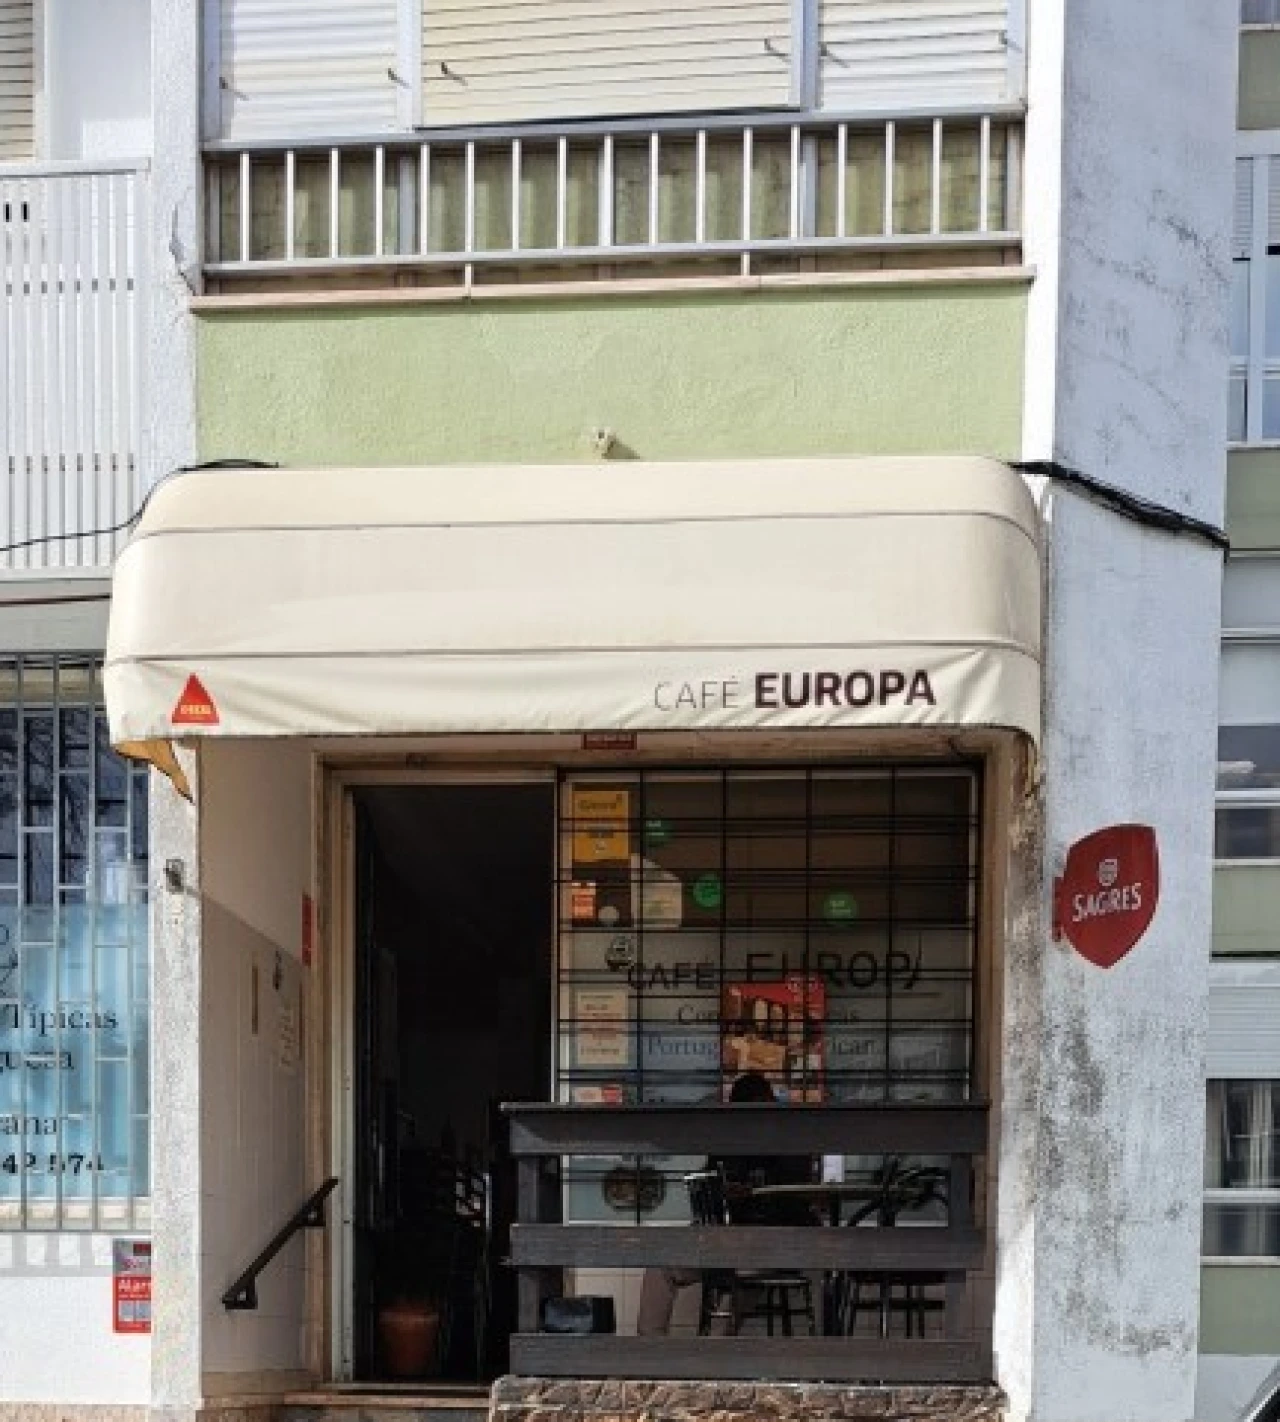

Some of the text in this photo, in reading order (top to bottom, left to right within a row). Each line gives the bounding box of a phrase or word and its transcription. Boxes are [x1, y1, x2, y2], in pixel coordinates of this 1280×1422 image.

[653, 668, 938, 711] CAFÉ EUROPA
[1071, 882, 1142, 922] SAGRES
